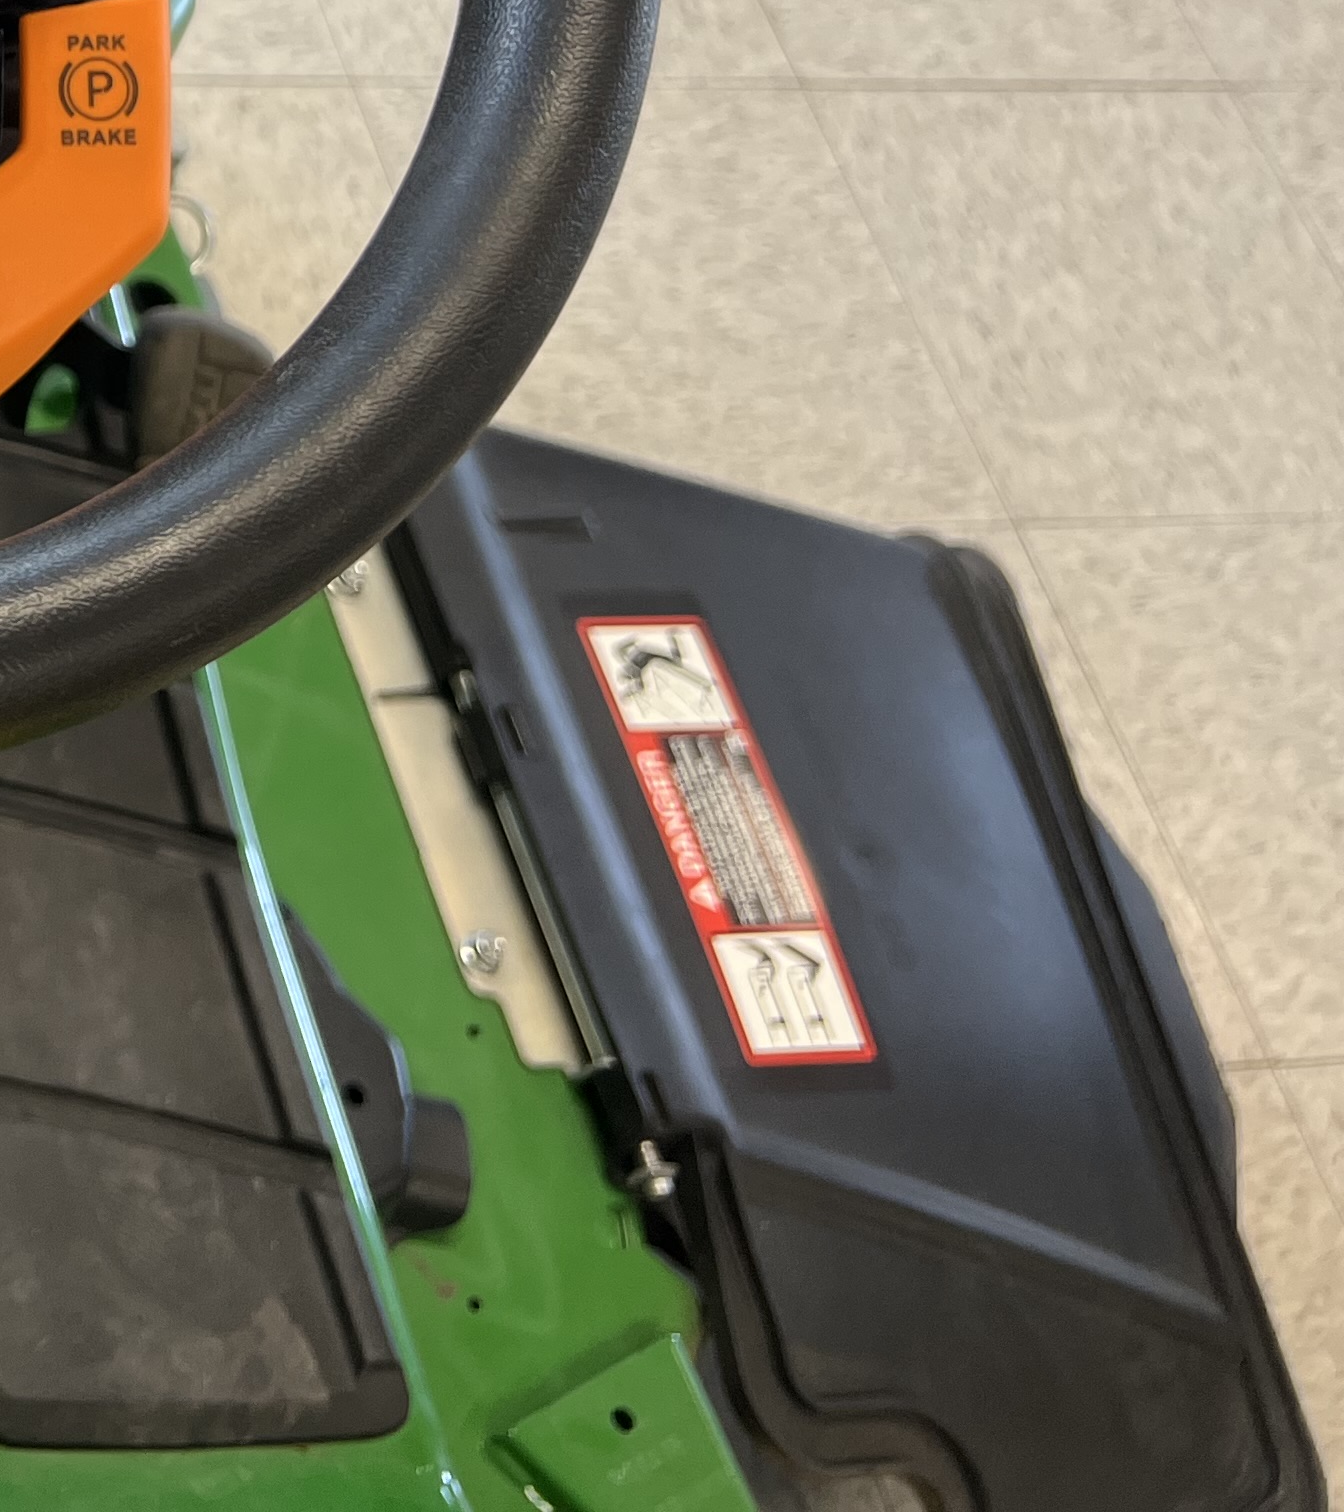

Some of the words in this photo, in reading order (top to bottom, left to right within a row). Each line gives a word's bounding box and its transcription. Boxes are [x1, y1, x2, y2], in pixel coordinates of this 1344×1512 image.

[67, 34, 127, 52] PARK
[61, 129, 138, 147] BRAKE
[636, 749, 706, 879] DANGER
